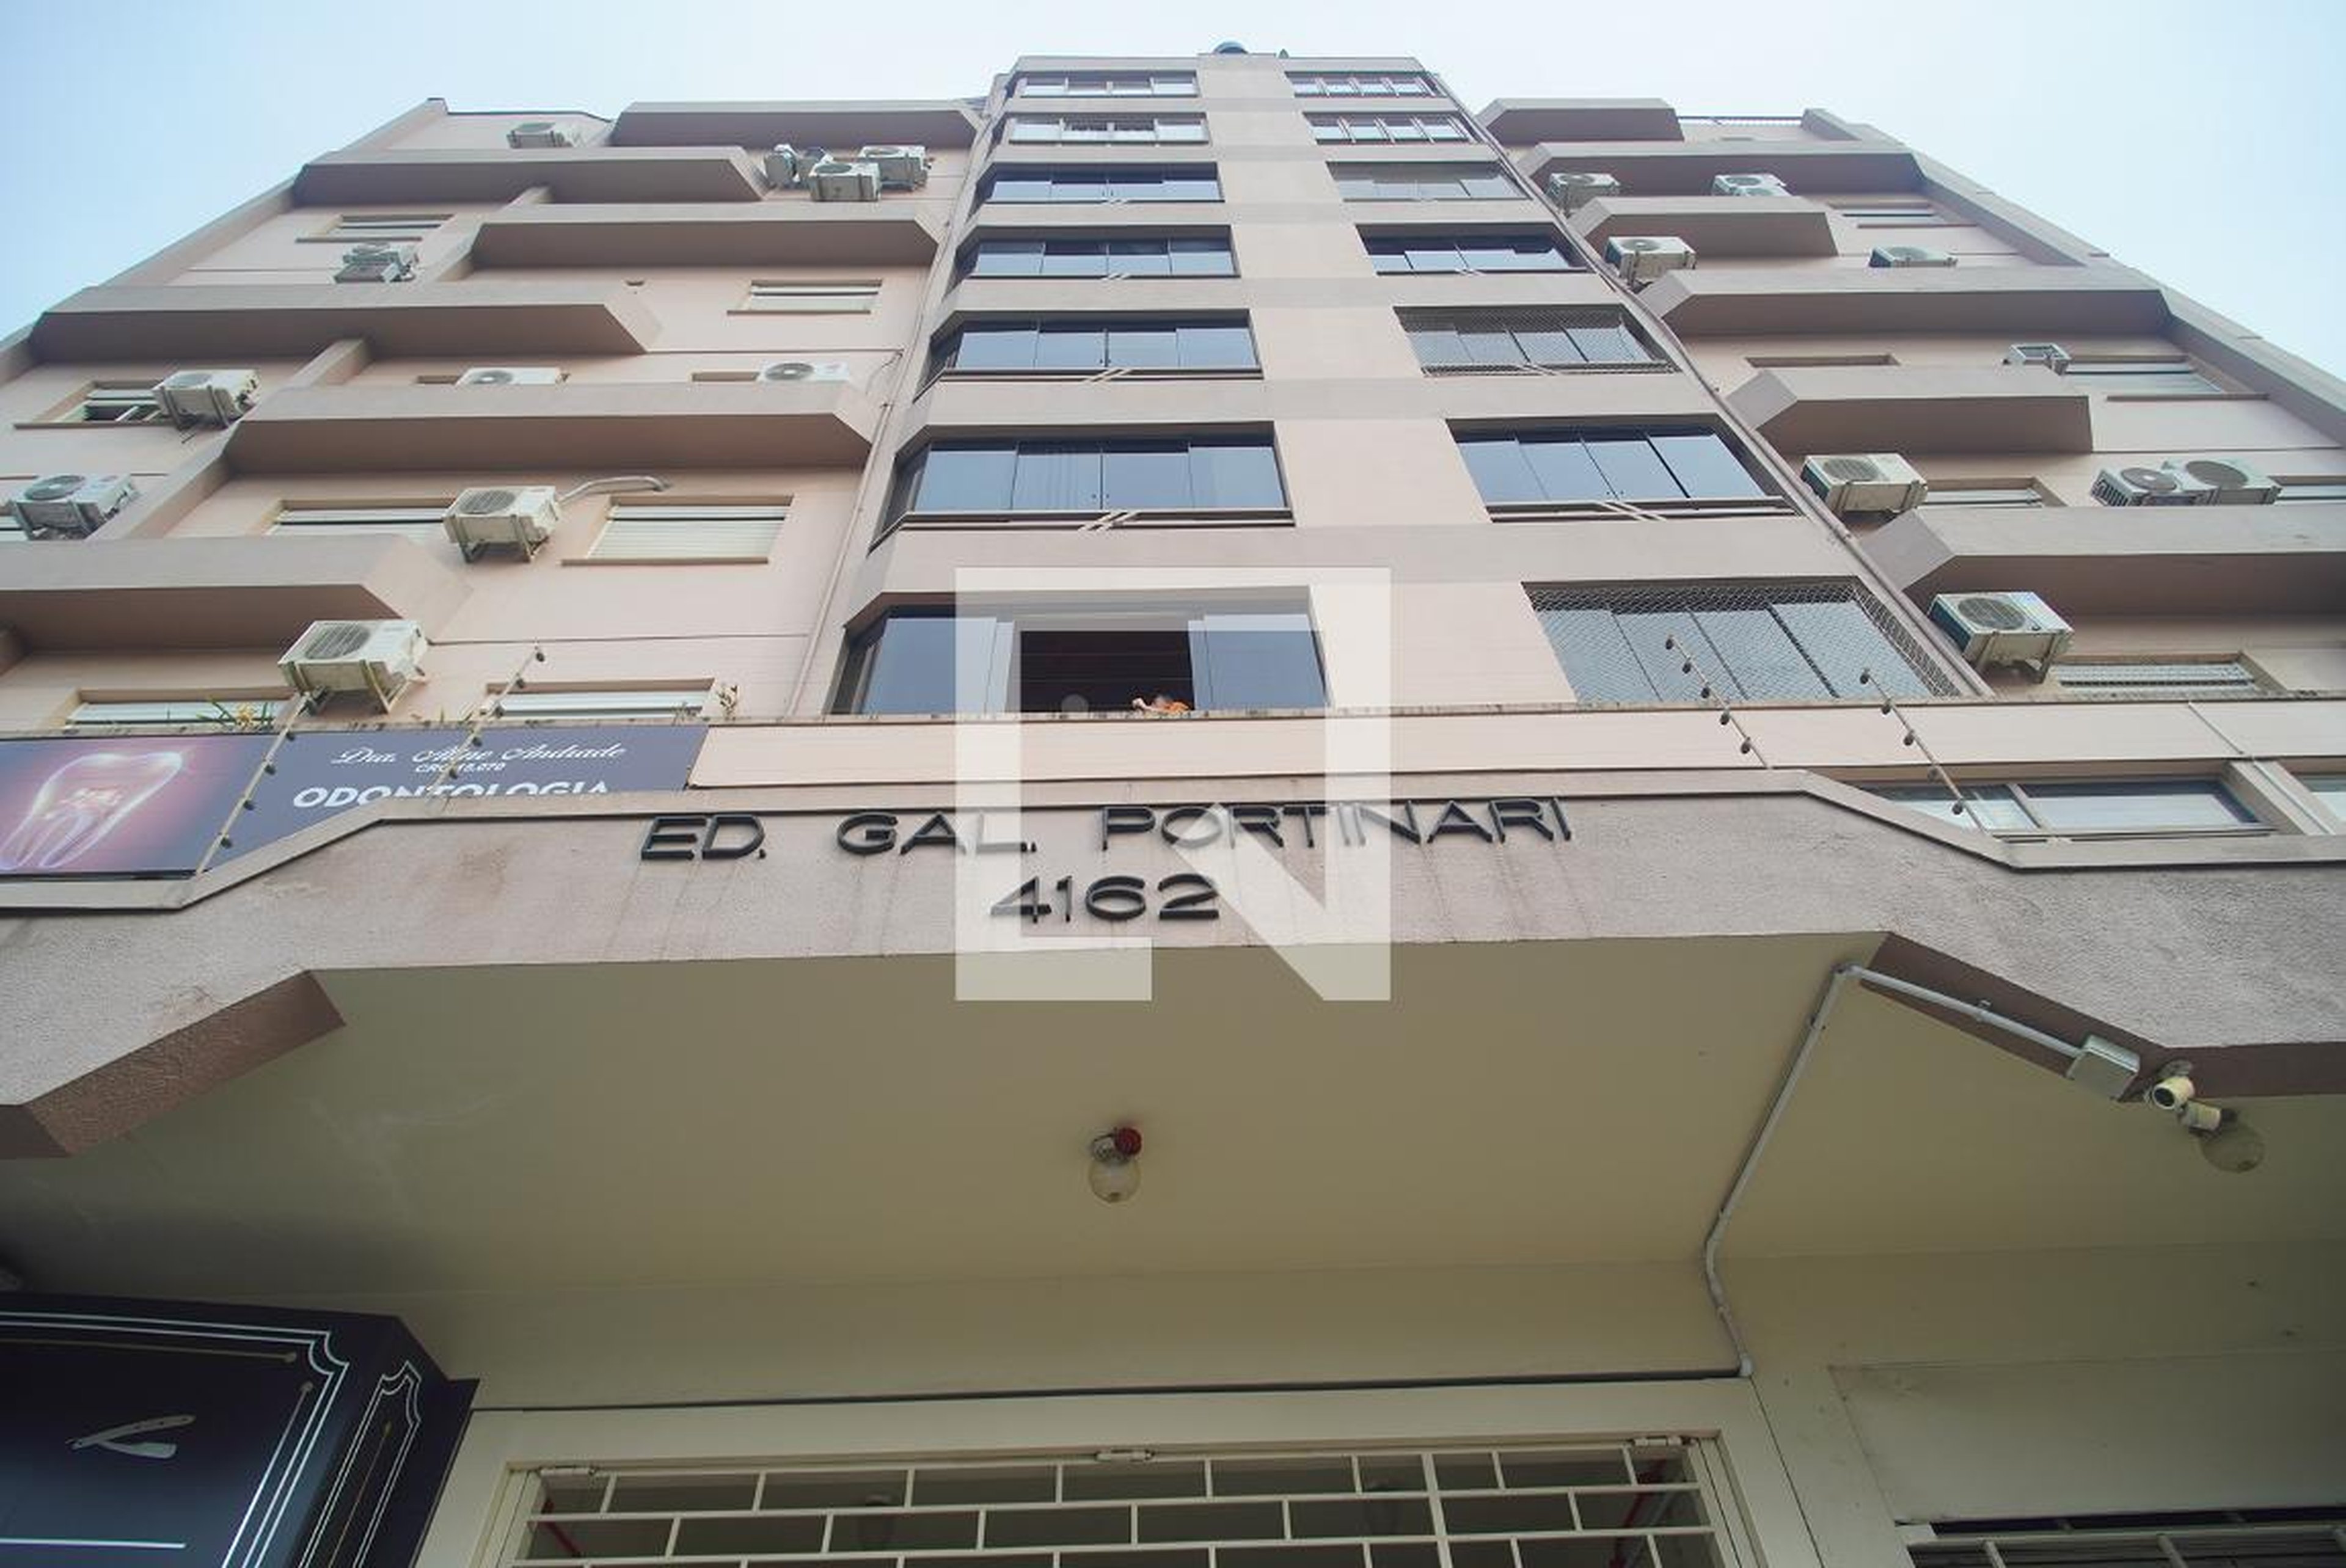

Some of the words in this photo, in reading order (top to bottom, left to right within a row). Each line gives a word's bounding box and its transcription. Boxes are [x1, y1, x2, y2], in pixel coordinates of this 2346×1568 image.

[641, 814, 766, 859] ED.
[837, 812, 1037, 856] GAL.
[1102, 798, 1572, 850] PORTINARI
[989, 873, 1219, 924] 4162
